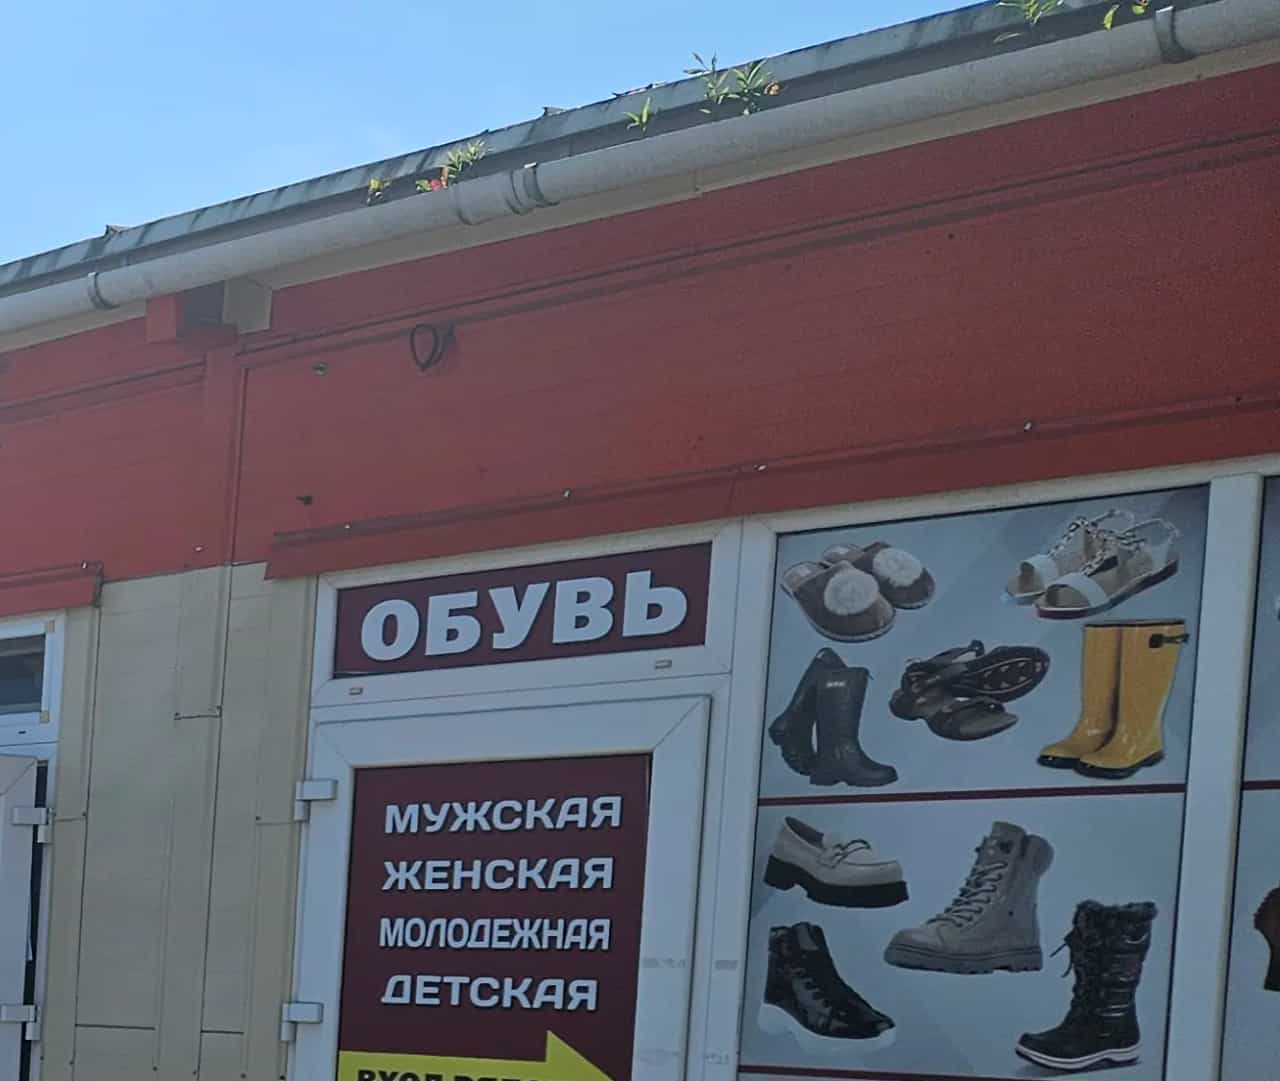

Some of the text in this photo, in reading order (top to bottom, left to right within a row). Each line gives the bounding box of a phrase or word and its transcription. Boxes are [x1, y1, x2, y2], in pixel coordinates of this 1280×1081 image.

[360, 569, 688, 662] ОБУВЬ
[384, 796, 624, 835] МУЖСКАЯ
[382, 856, 615, 891] ЖЕНСКАЯ
[380, 917, 611, 951] МОЛОДЕЖНАЯ
[381, 975, 599, 1011] ДЕТСКАЯ
